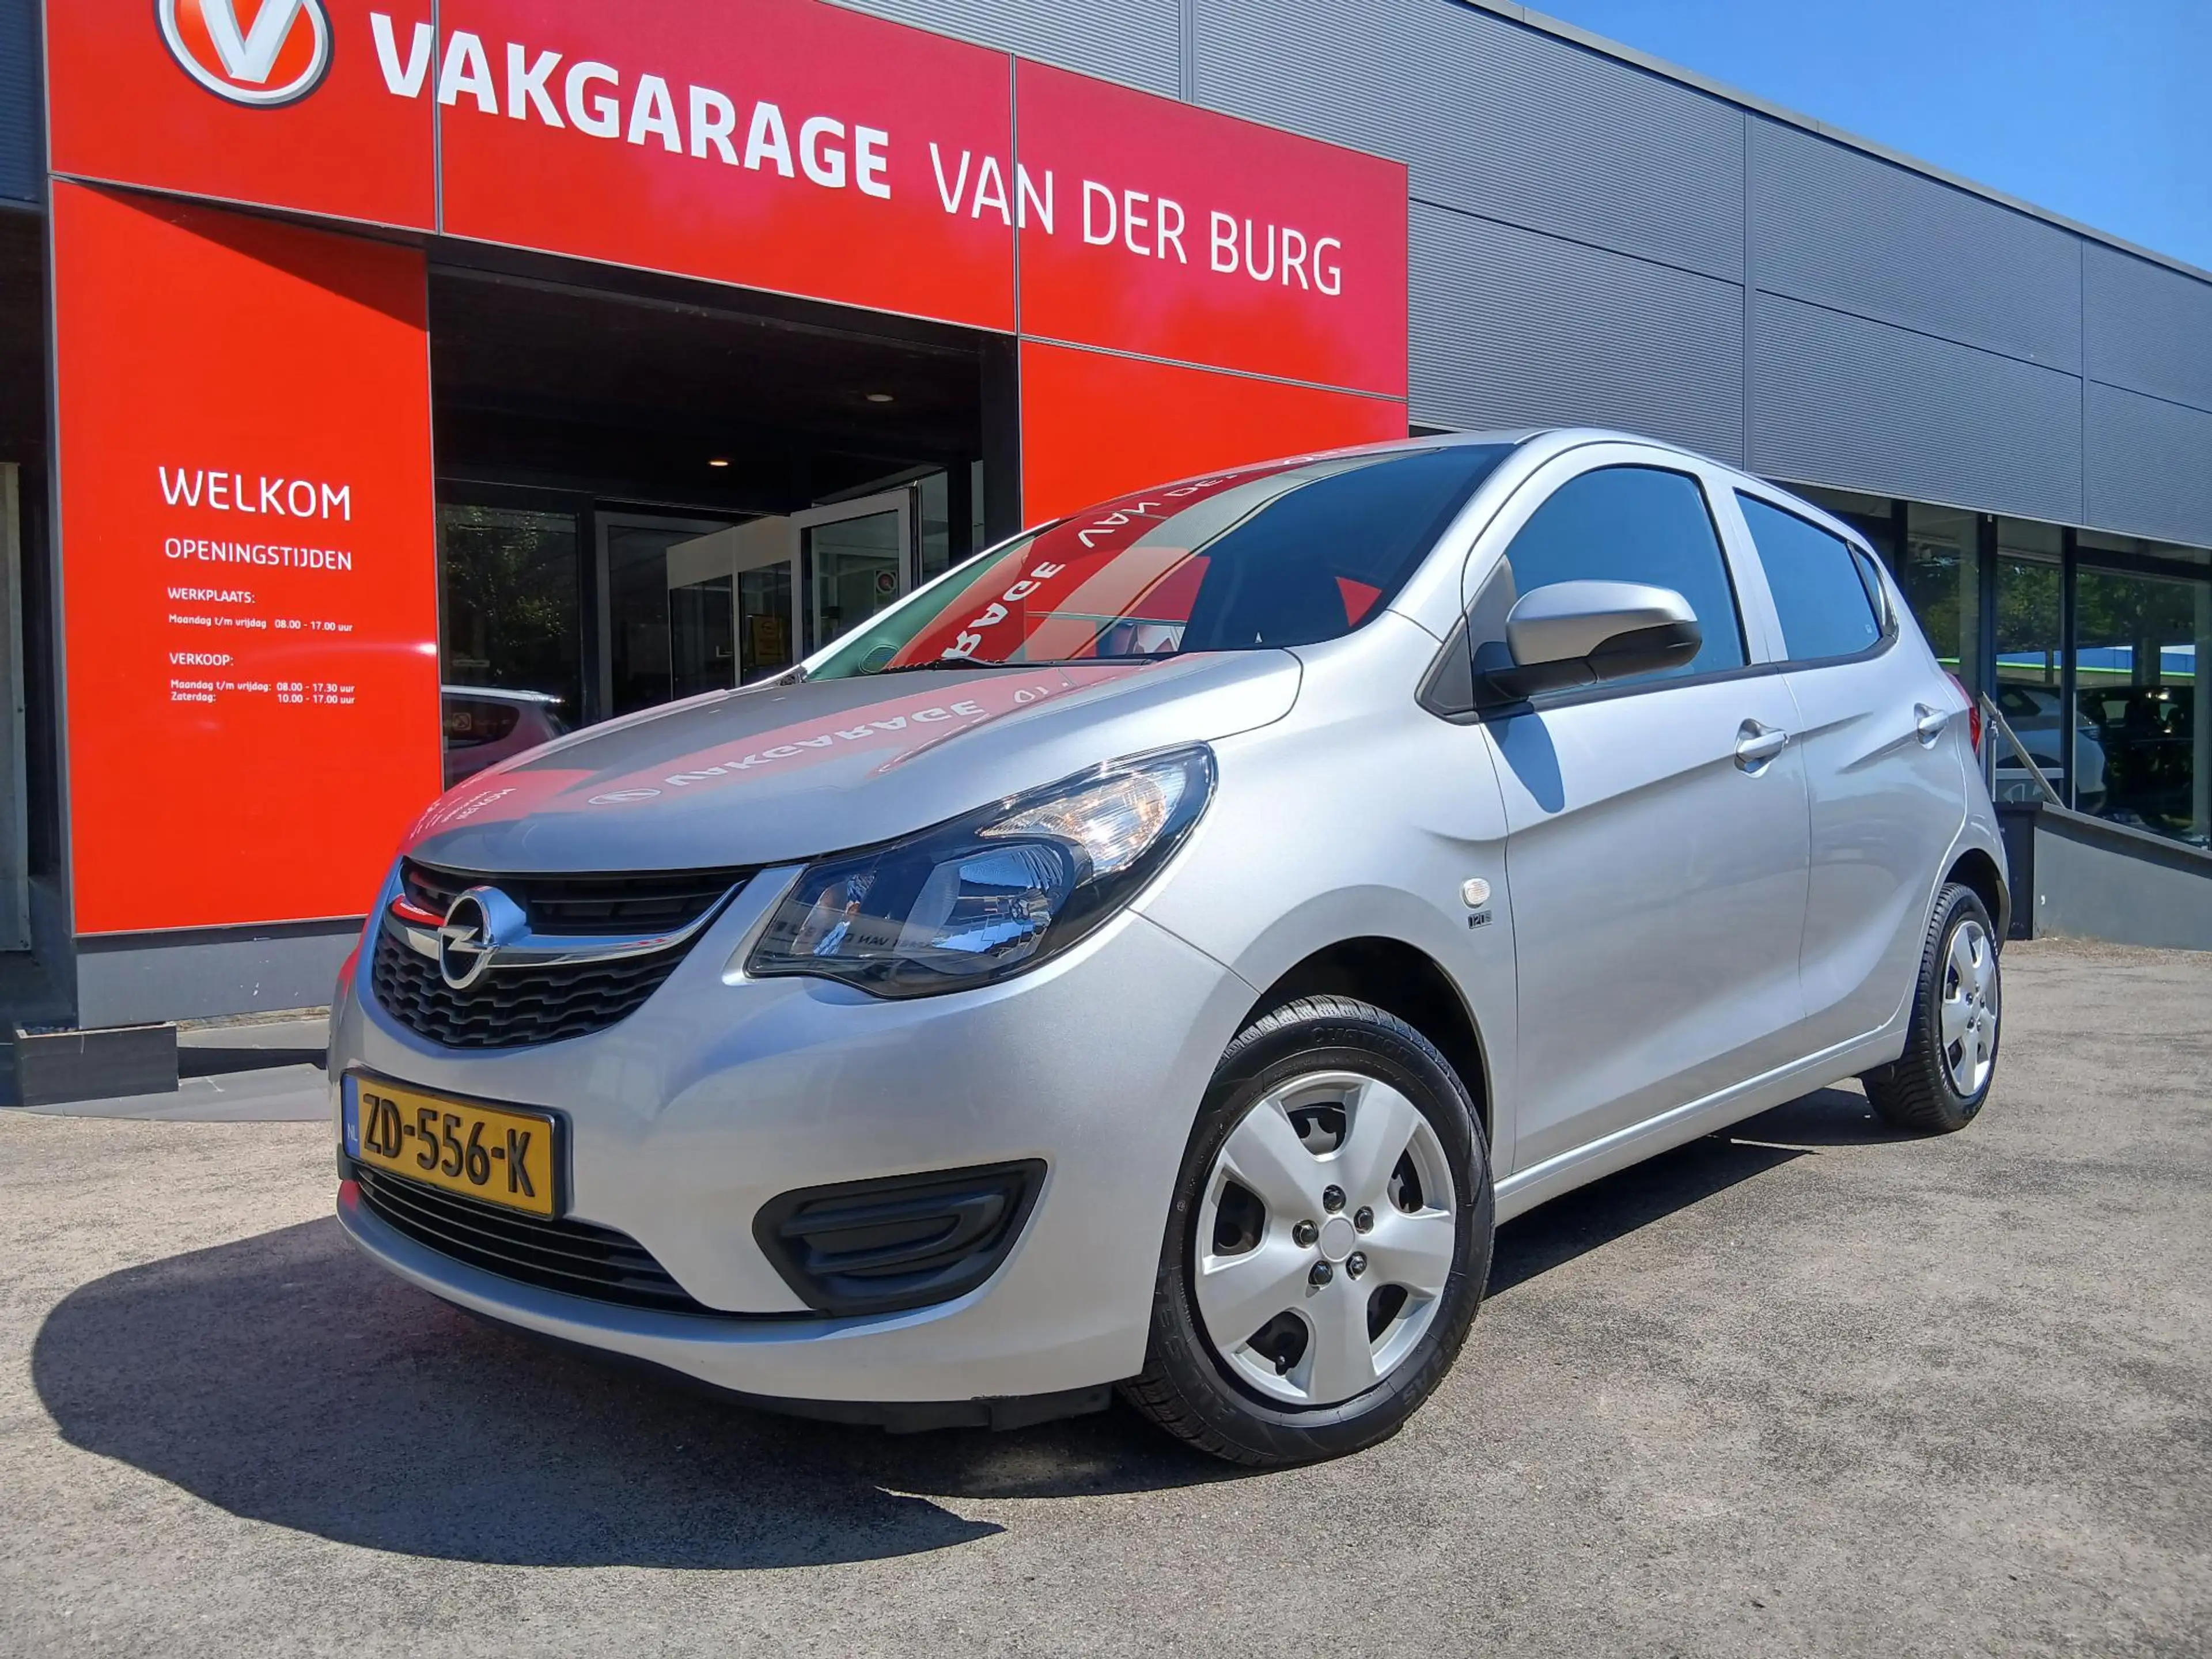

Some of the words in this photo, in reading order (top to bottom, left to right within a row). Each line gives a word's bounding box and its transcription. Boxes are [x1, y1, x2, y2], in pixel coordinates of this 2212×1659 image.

[369, 12, 891, 199] VAKGARAGE
[929, 142, 1054, 235] VAN
[1082, 179, 1188, 265] DER
[1210, 211, 1342, 296] BURG
[158, 466, 350, 521] WELKOM
[165, 537, 351, 571] OPENINGSTIJDEN
[168, 587, 255, 604] WERKPLAATS:
[169, 614, 212, 627] Maandag
[214, 616, 233, 627] t/m
[236, 618, 267, 629] vrijdag
[274, 619, 301, 629] 08.00
[310, 621, 336, 631] 17.00
[169, 653, 234, 666] VERKOOP:
[171, 680, 214, 691] Maandag
[216, 680, 234, 691] t/m
[237, 681, 272, 692] vrijdag:
[276, 682, 303, 692] 08.00
[313, 683, 338, 692] 17.30
[171, 691, 217, 703] Zaterdag:
[278, 694, 304, 703] 10.00
[313, 695, 338, 704] 17.00
[347, 1123, 358, 1142] NL
[363, 1093, 536, 1198] ZD-556-K
